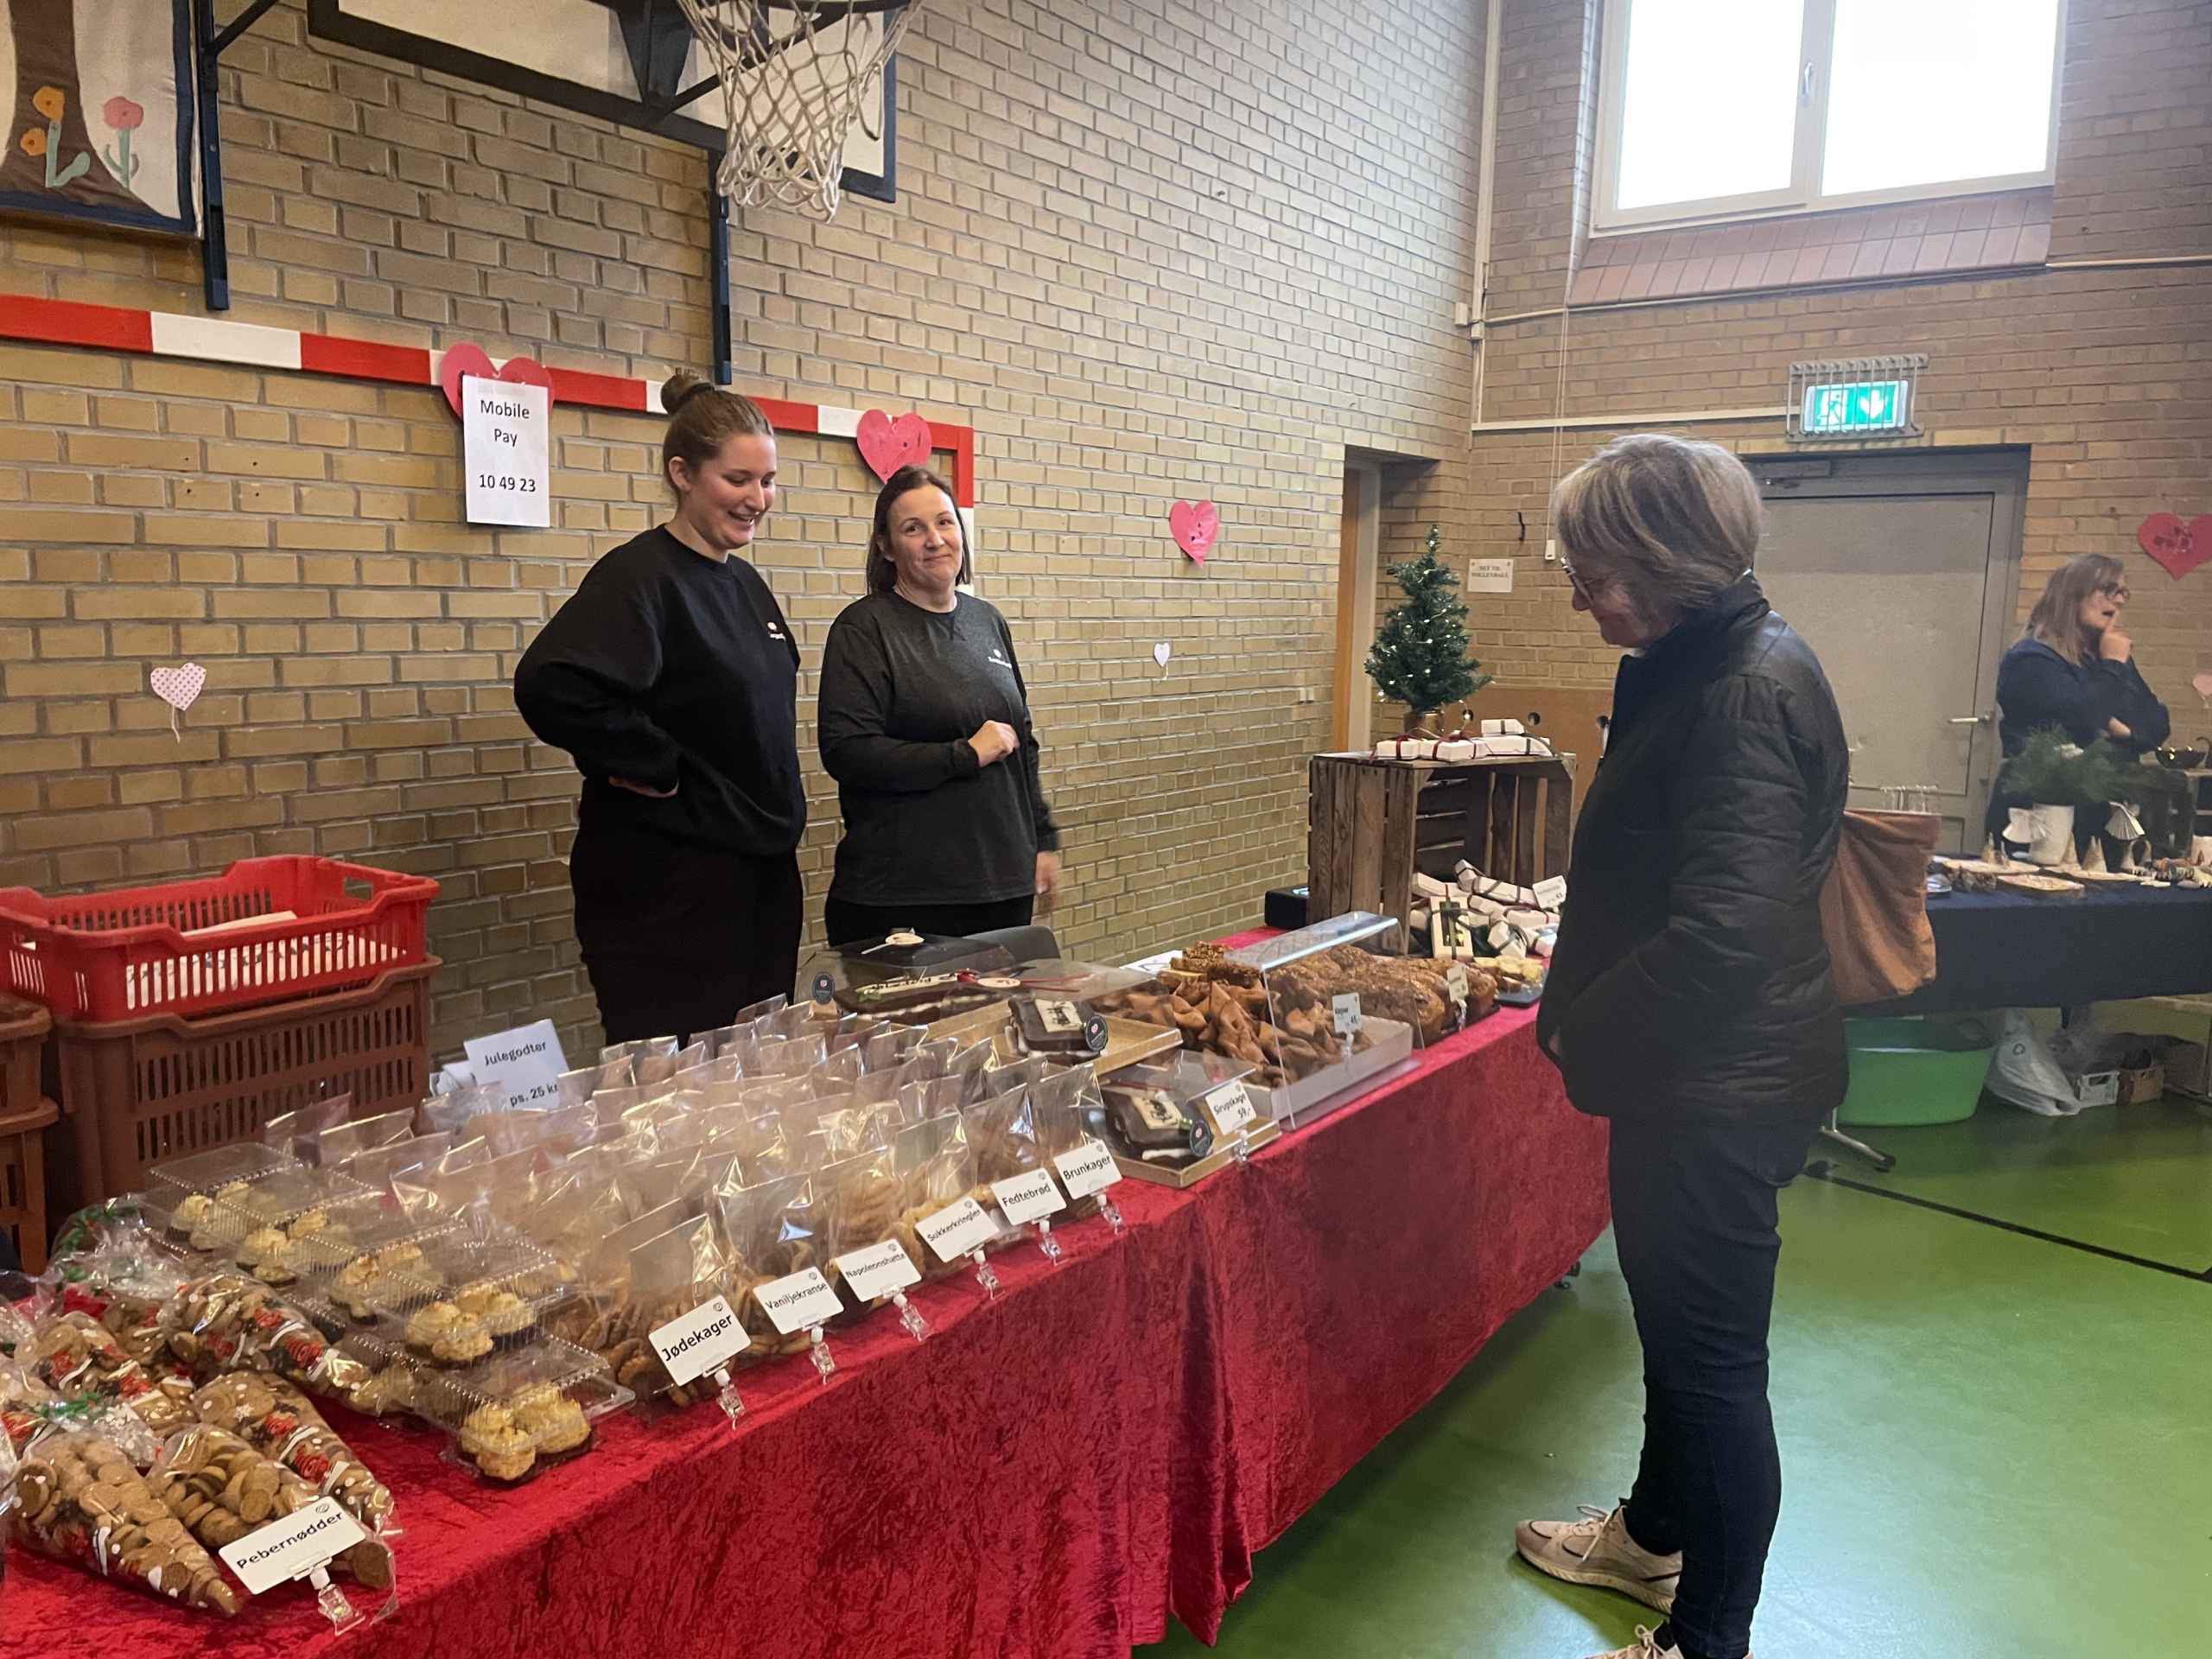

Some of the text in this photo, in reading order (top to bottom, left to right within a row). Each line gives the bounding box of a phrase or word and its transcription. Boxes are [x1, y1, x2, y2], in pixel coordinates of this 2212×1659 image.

[480, 400, 530, 420] Mobile
[494, 429, 518, 448] Pay
[480, 474, 536, 493] 10 49 23
[485, 1042, 546, 1065] Julegodter
[530, 1085, 545, 1099] 25
[1063, 1155, 1111, 1180] Brunkager
[1001, 1184, 1051, 1206] Fedtebrød
[765, 1282, 829, 1309] Vaniljekranse
[662, 1314, 734, 1362] Jødekager
[237, 1512, 343, 1568] Pebernødder
